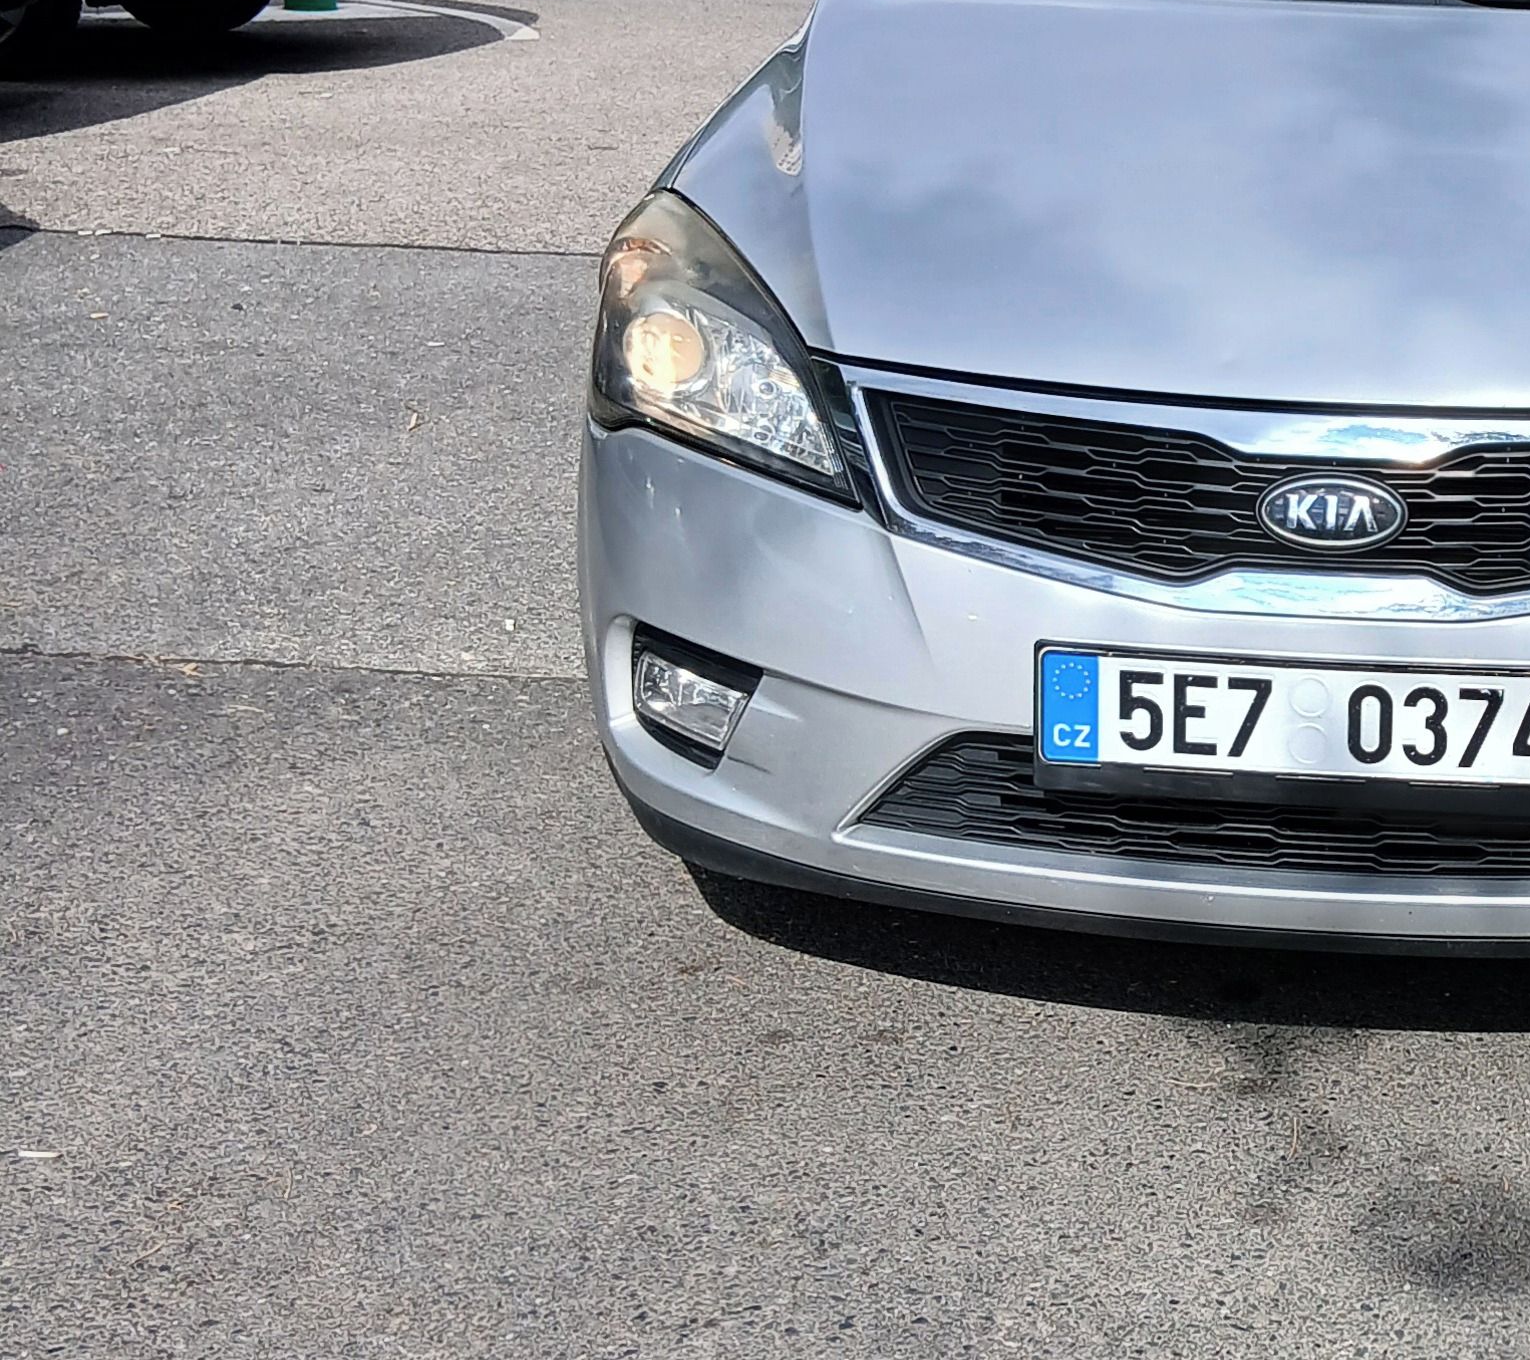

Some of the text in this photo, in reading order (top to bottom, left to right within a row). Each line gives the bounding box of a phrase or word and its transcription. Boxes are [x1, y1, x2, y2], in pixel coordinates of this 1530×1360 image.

[1285, 493, 1379, 533] KIA
[1118, 669, 1274, 758] 5E7
[1052, 722, 1092, 749] CZ
